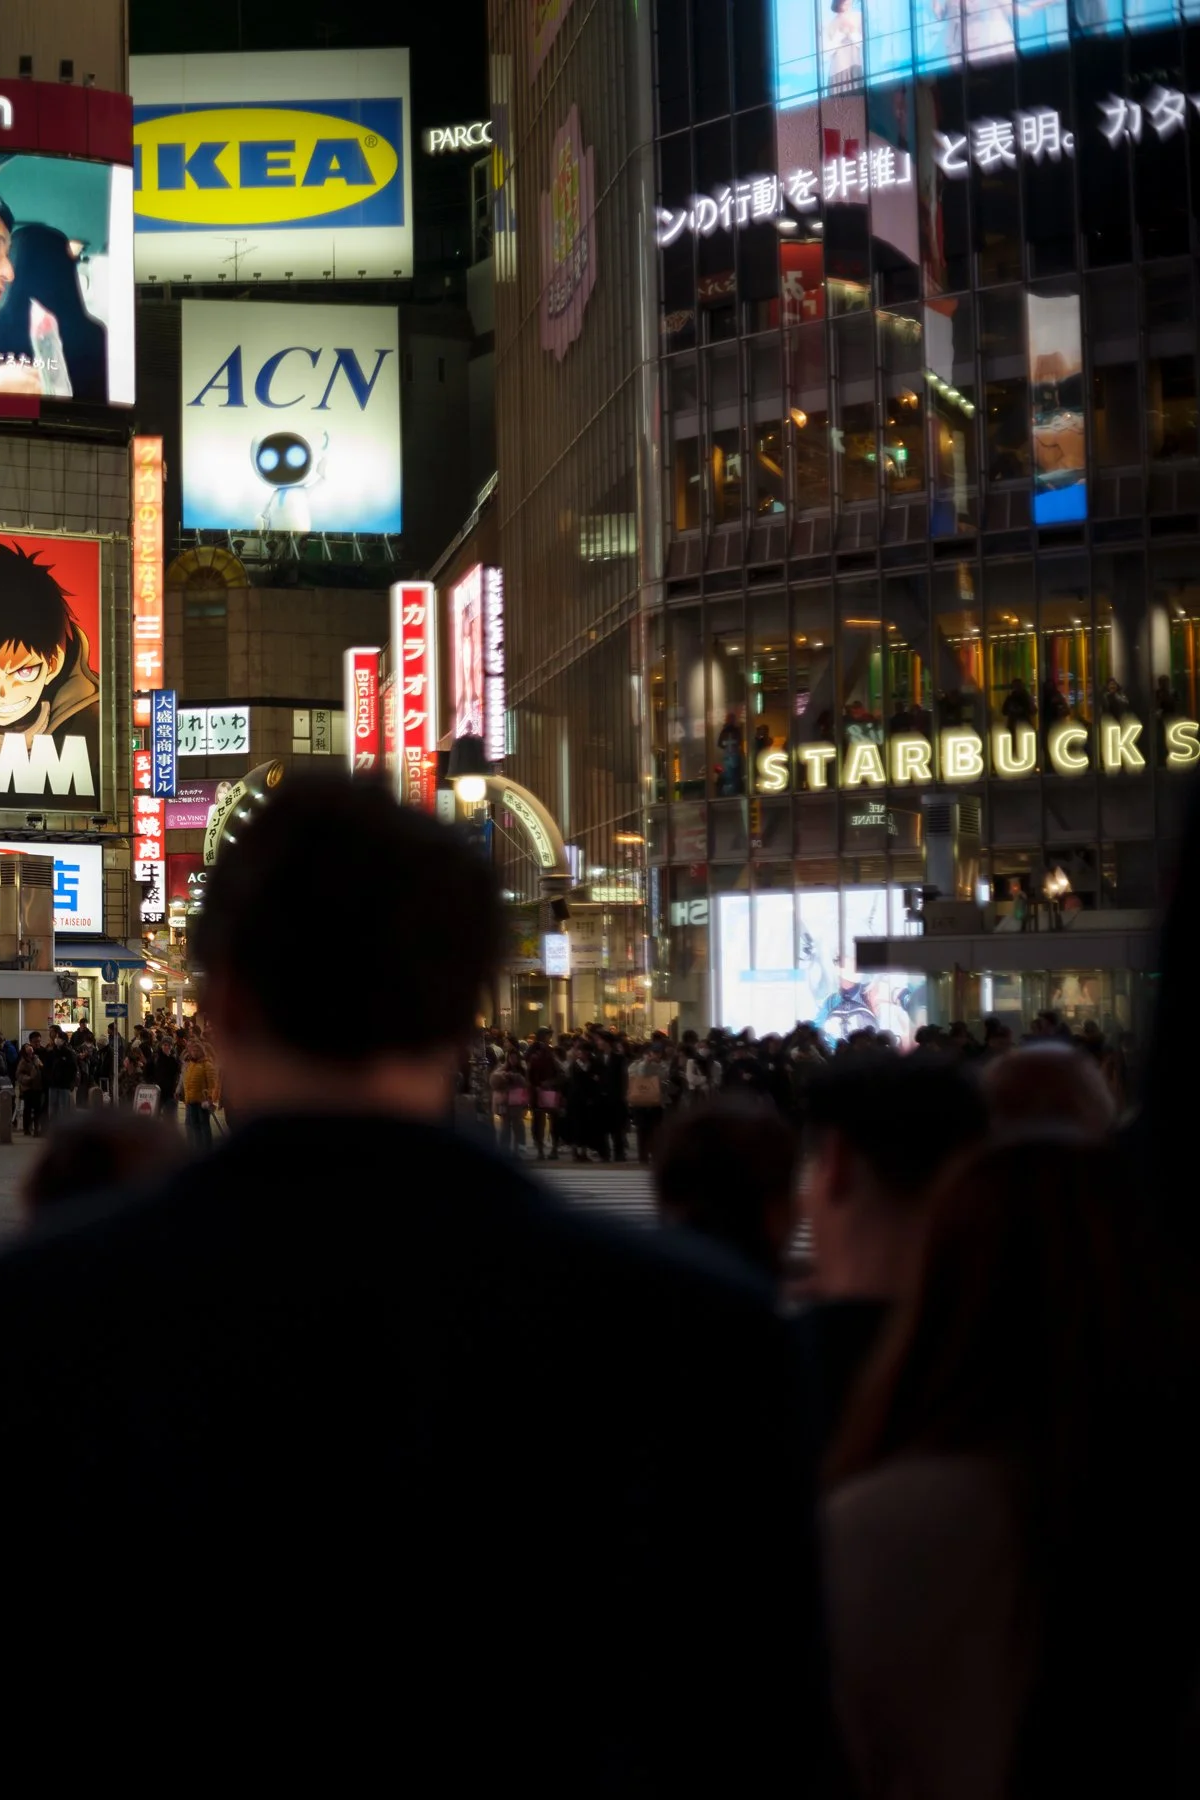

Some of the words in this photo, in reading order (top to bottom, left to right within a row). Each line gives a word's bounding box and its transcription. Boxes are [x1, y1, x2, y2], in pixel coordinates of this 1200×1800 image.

[186, 345, 394, 411] ACN
[355, 669, 369, 696] BIG
[402, 604, 427, 730] カラオケ
[188, 713, 246, 731] れいわ
[315, 711, 326, 750] 皮フ科
[356, 699, 370, 737] ECHO
[156, 695, 173, 794] 大盛堂商事ビル
[762, 720, 1200, 790] STARBUCKS
